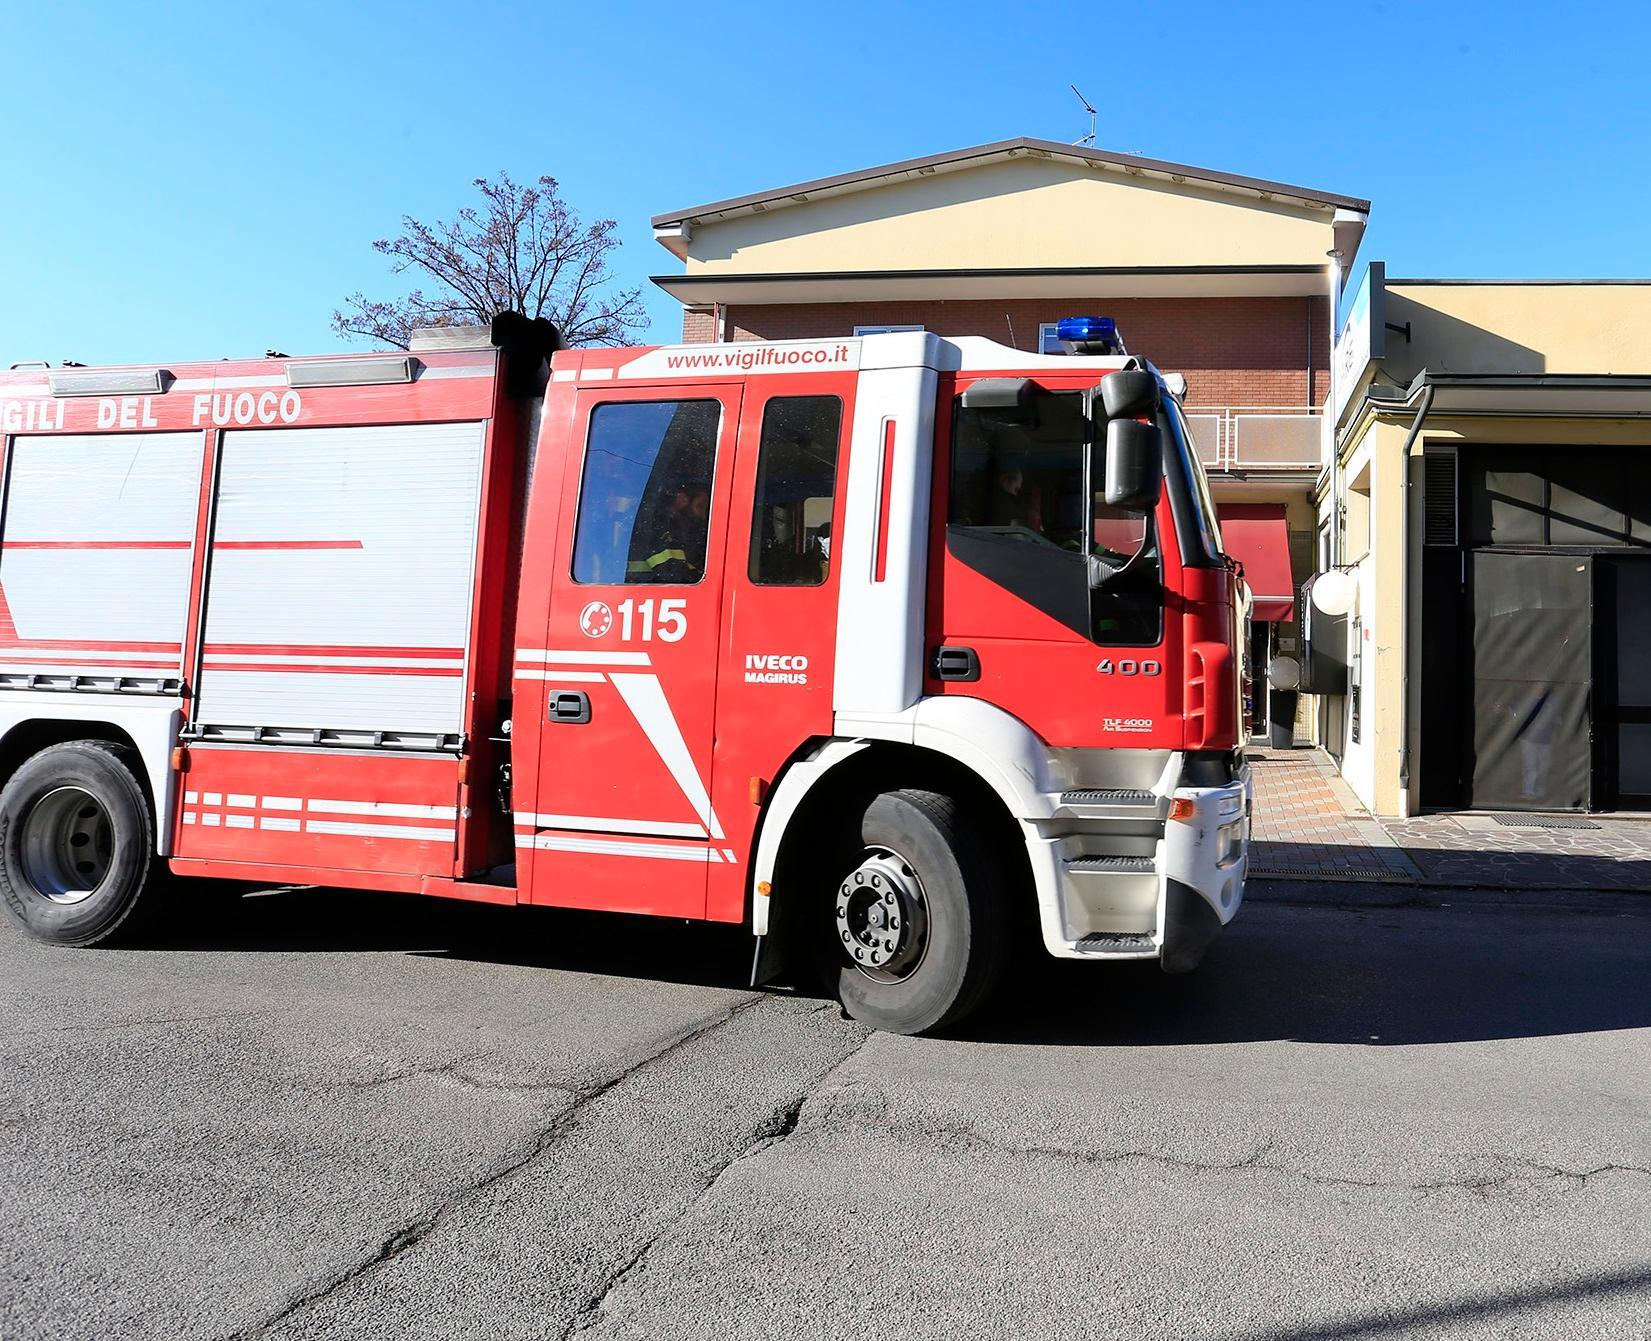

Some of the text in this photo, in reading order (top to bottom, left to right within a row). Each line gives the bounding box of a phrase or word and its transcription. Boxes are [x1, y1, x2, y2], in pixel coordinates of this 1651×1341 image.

[667, 345, 849, 370] www.vigilfuoco.it
[97, 398, 159, 429] DEL
[193, 390, 302, 426] FUOCO
[617, 598, 688, 643] 115
[745, 654, 809, 671] IVECO
[1096, 658, 1162, 675] 400
[744, 672, 808, 685] MAGIRUS
[1102, 717, 1153, 727] TLF 4000
